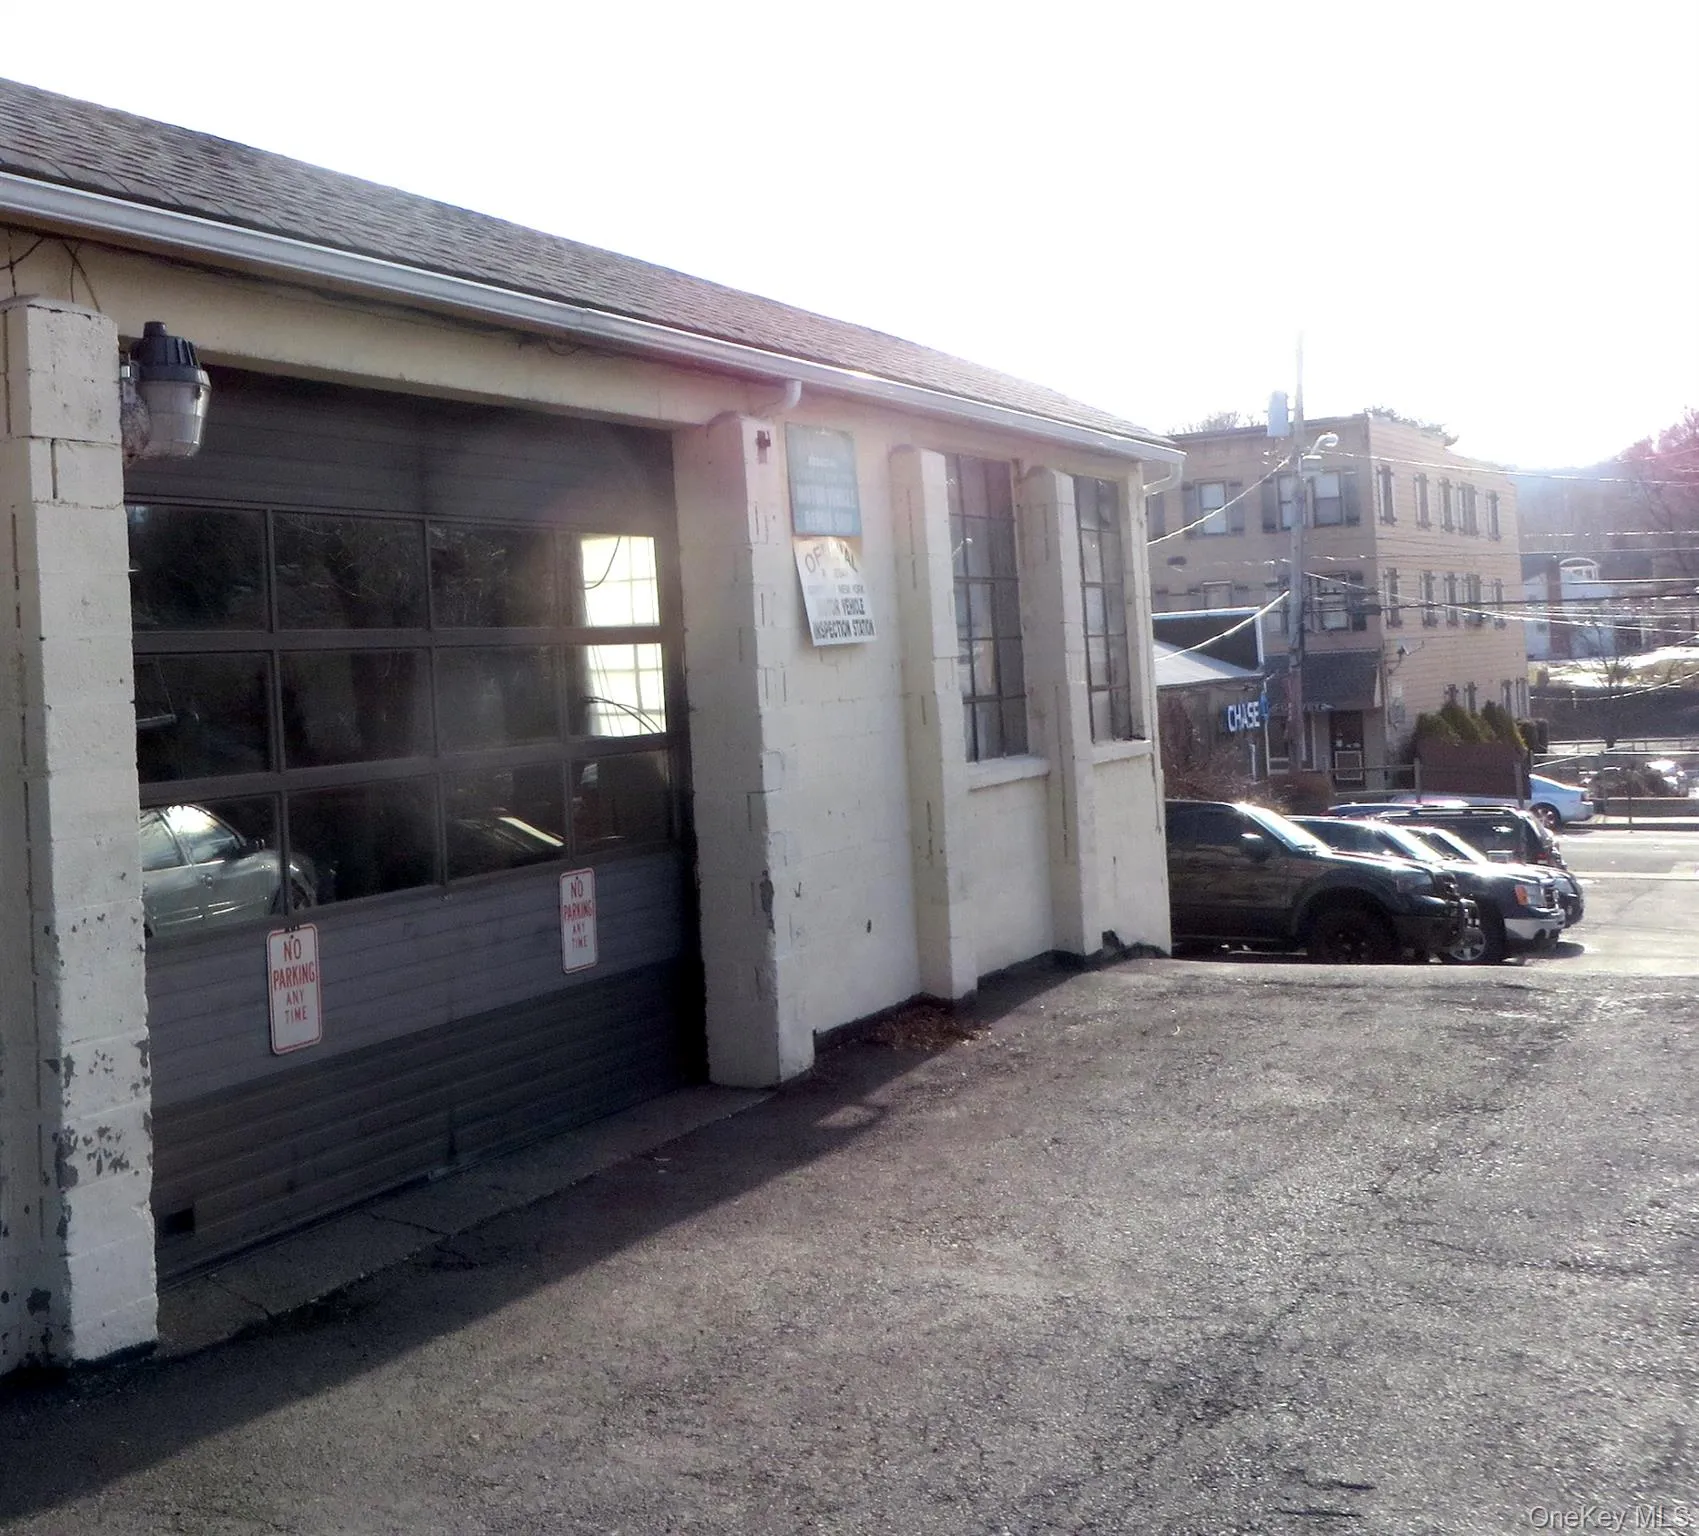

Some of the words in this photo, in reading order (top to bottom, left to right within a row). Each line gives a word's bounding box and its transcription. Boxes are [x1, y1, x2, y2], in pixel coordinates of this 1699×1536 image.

[813, 619, 852, 640] INSPECTION
[852, 618, 875, 636] STATION
[1227, 701, 1260, 732] CHASE
[570, 880, 583, 898] NO
[563, 900, 592, 922] PARKING
[573, 922, 585, 935] ANY
[284, 939, 302, 961] NO
[572, 935, 588, 949] TIME
[273, 962, 315, 989] PARKING
[286, 989, 305, 1006] ANY
[285, 1005, 307, 1023] TIME
